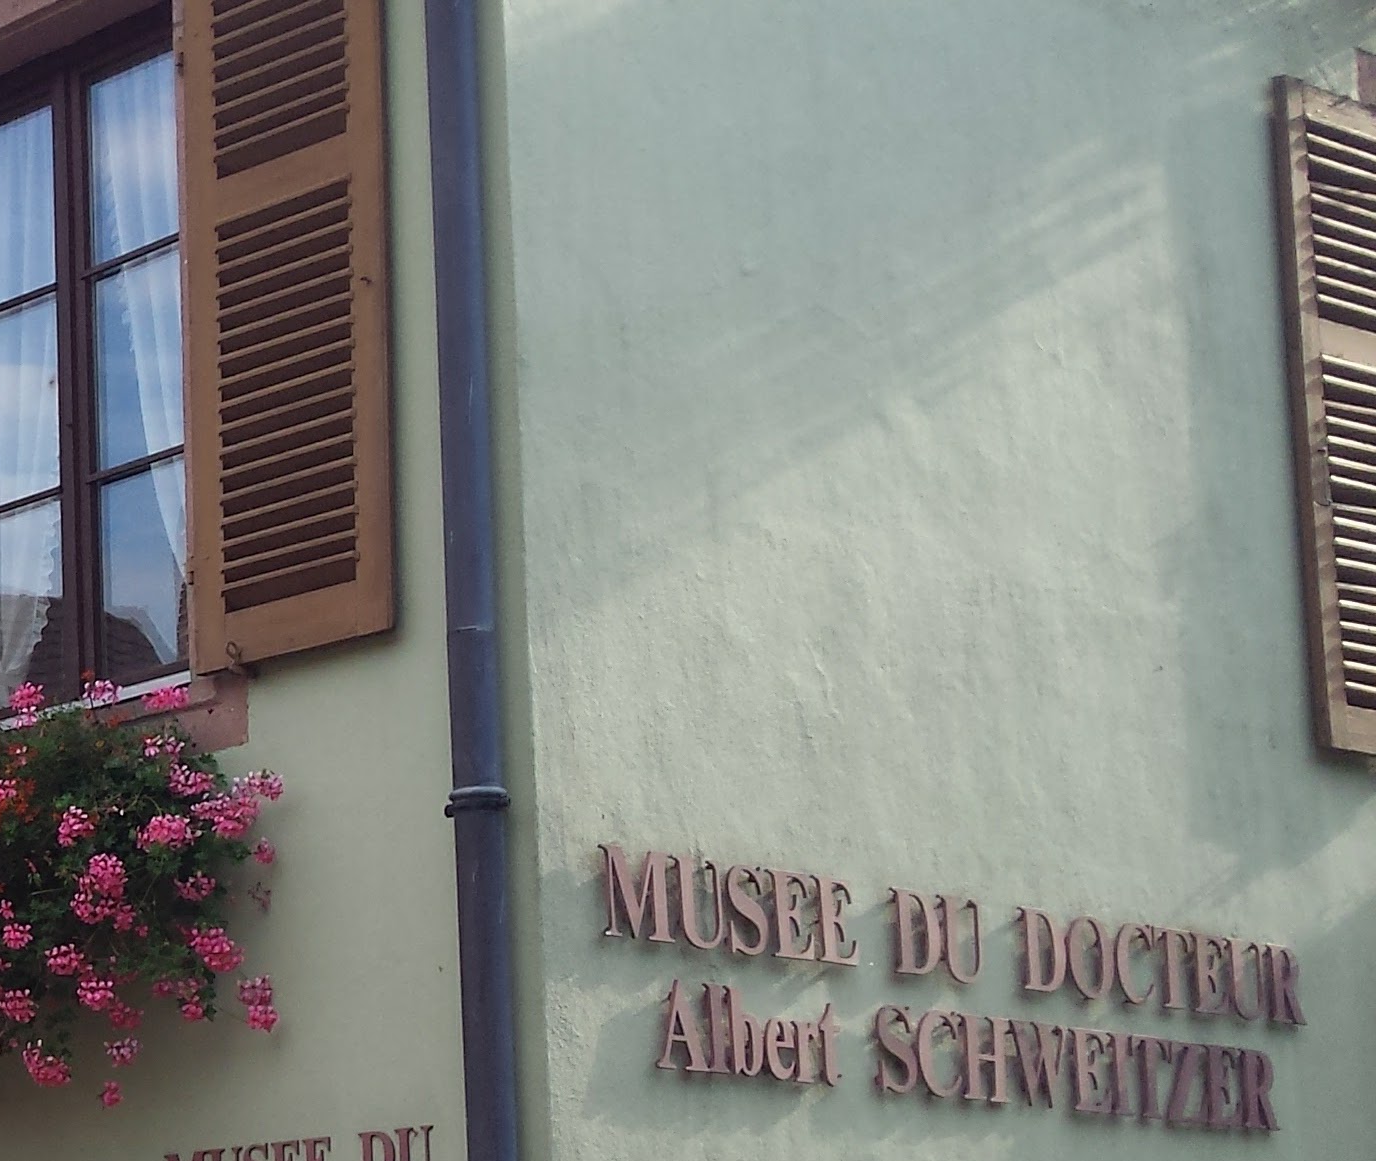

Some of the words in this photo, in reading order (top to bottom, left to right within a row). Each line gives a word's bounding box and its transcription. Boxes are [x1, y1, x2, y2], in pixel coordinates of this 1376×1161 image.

[598, 843, 861, 968] MUSEE
[889, 886, 984, 985] DU
[1016, 906, 1308, 1027] DOCTEUR
[656, 979, 843, 1088] Albert
[874, 1004, 1282, 1133] SCHWEITZER
